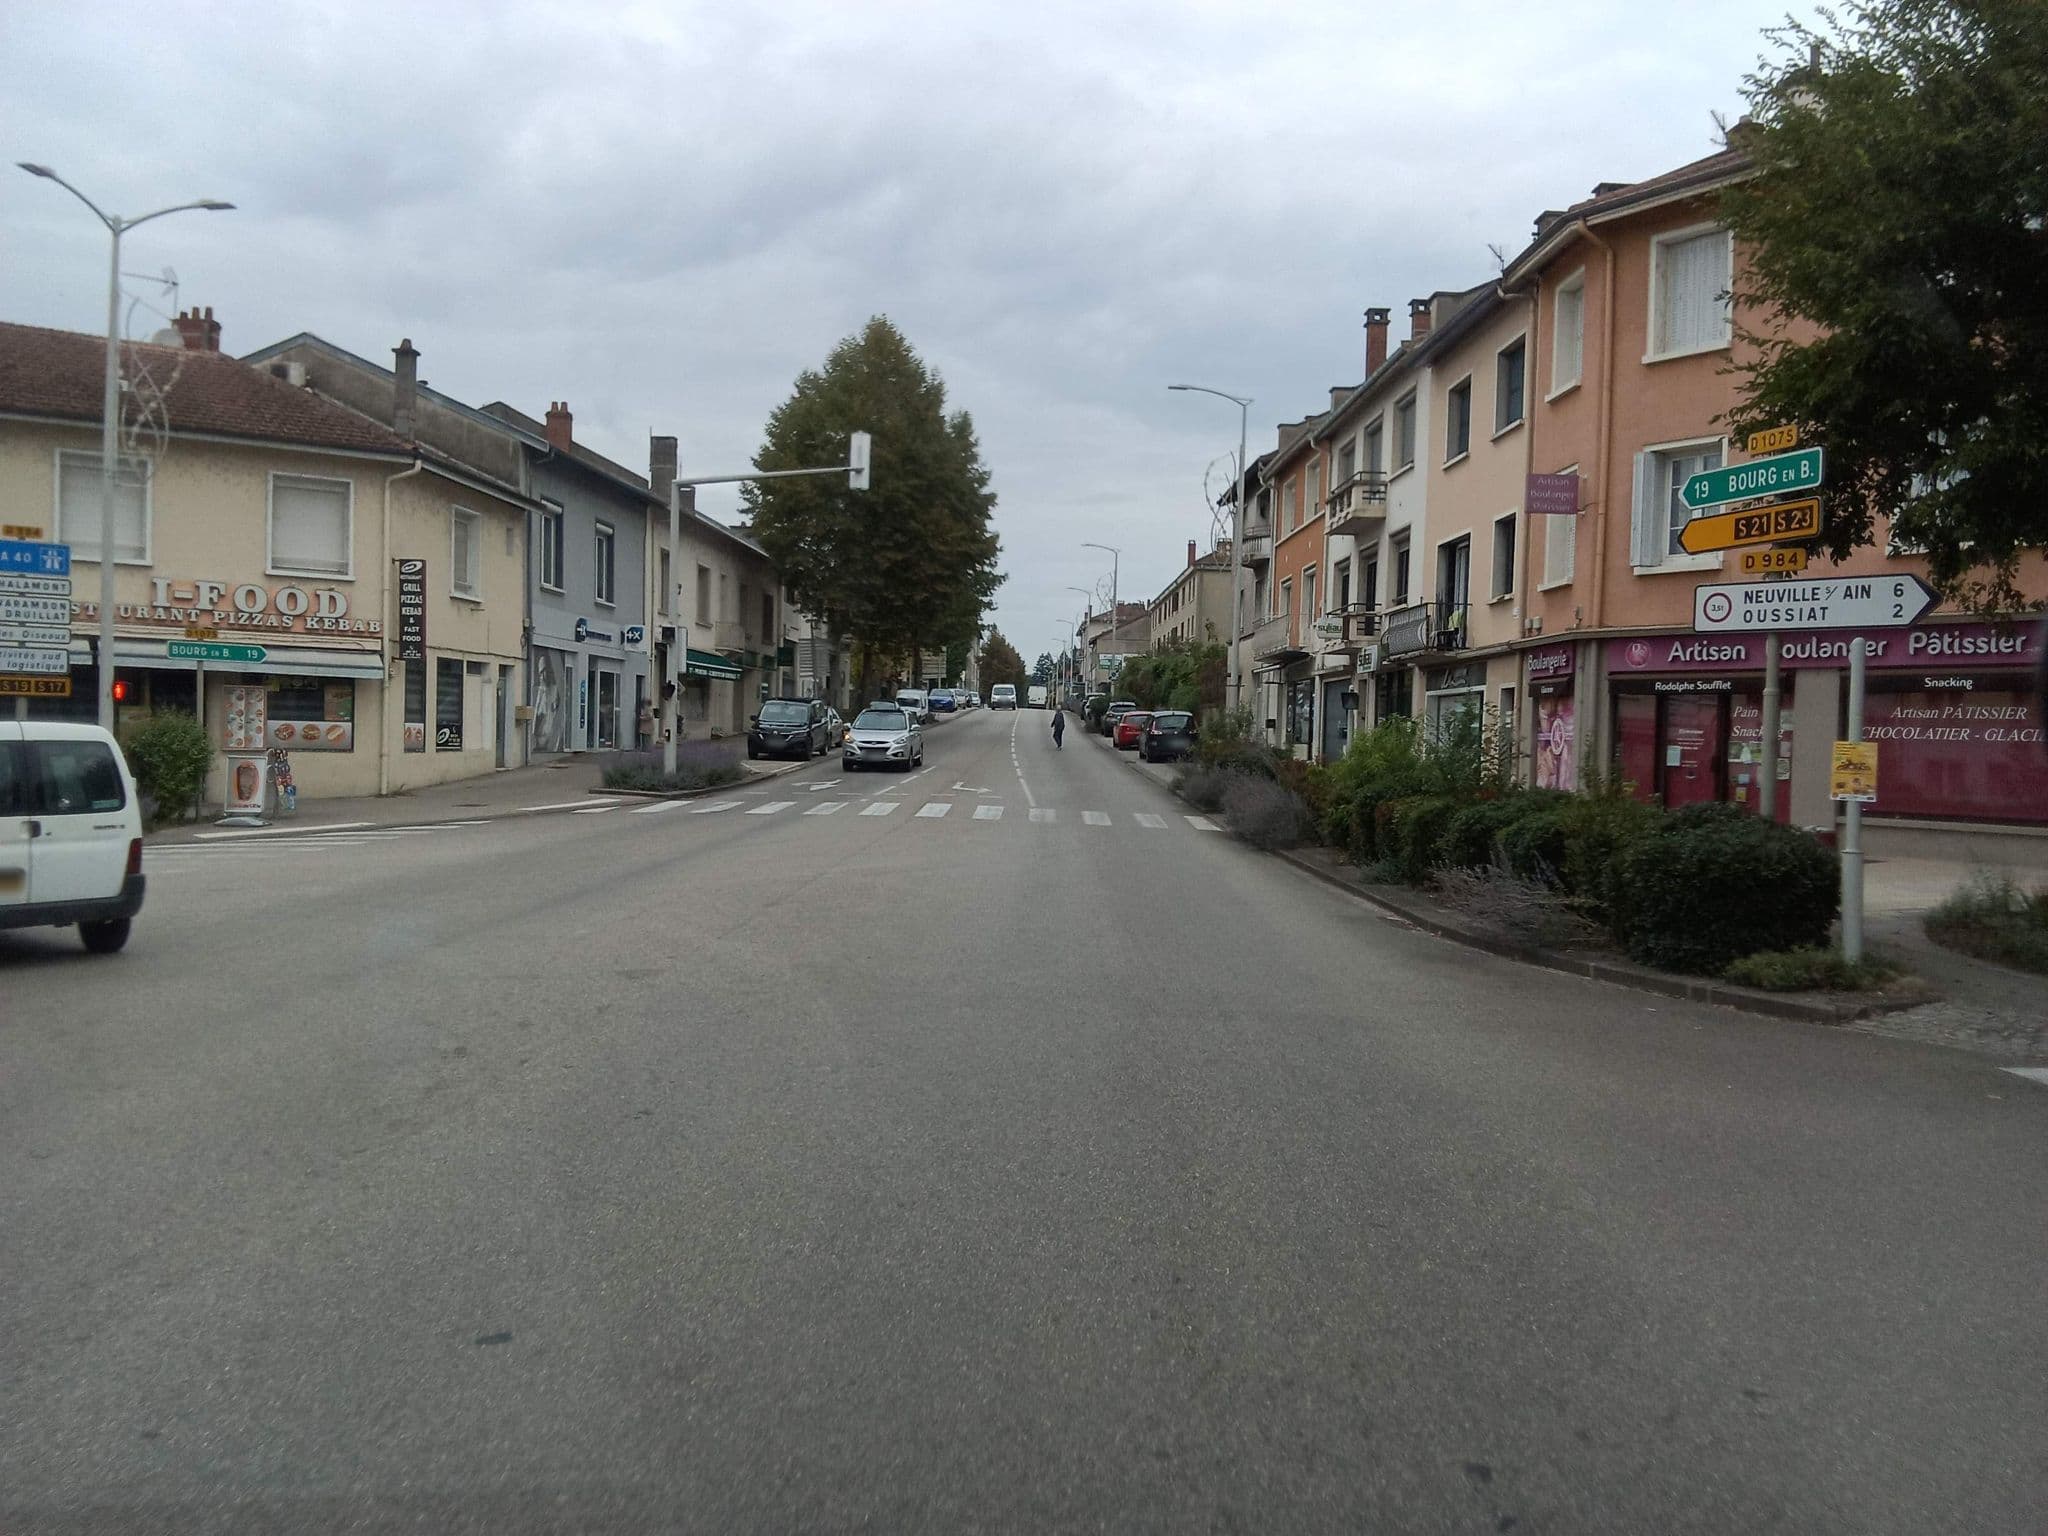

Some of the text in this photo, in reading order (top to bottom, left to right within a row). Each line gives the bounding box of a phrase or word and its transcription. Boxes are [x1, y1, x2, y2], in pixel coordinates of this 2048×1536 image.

[1694, 460, 1815, 498] 19 BOURG EN B.
[15, 551, 31, 563] 40
[1745, 552, 1798, 569] D 984
[0, 580, 66, 590] HALAMONT
[402, 583, 421, 592] GRILL
[152, 577, 347, 619] I-FOOD
[401, 595, 422, 603] PIZZAS
[1744, 587, 1821, 604] NEUVILLE
[1843, 584, 1871, 600] AIN
[1893, 583, 1904, 598] 6
[6, 610, 66, 620] DRUILLAT
[402, 607, 422, 615] KEBAB
[1743, 604, 1903, 623] OUSSIAT 2
[213, 611, 294, 628] PIZZAS
[305, 616, 381, 633] KEBAB
[22, 631, 66, 640] Oiseaux
[172, 645, 207, 655] BOURG
[247, 650, 258, 658] 19
[1667, 629, 2027, 664] Artisan oulaner Pâtissier
[7, 661, 65, 671] logistique
[1528, 649, 1567, 673] Boulangerie
[1655, 680, 1732, 692] Rodolphe Soufflet
[1924, 677, 1974, 690] Snacking
[1733, 705, 1759, 718] Pain
[1890, 704, 2028, 720] Artisan PÂTISSIER
